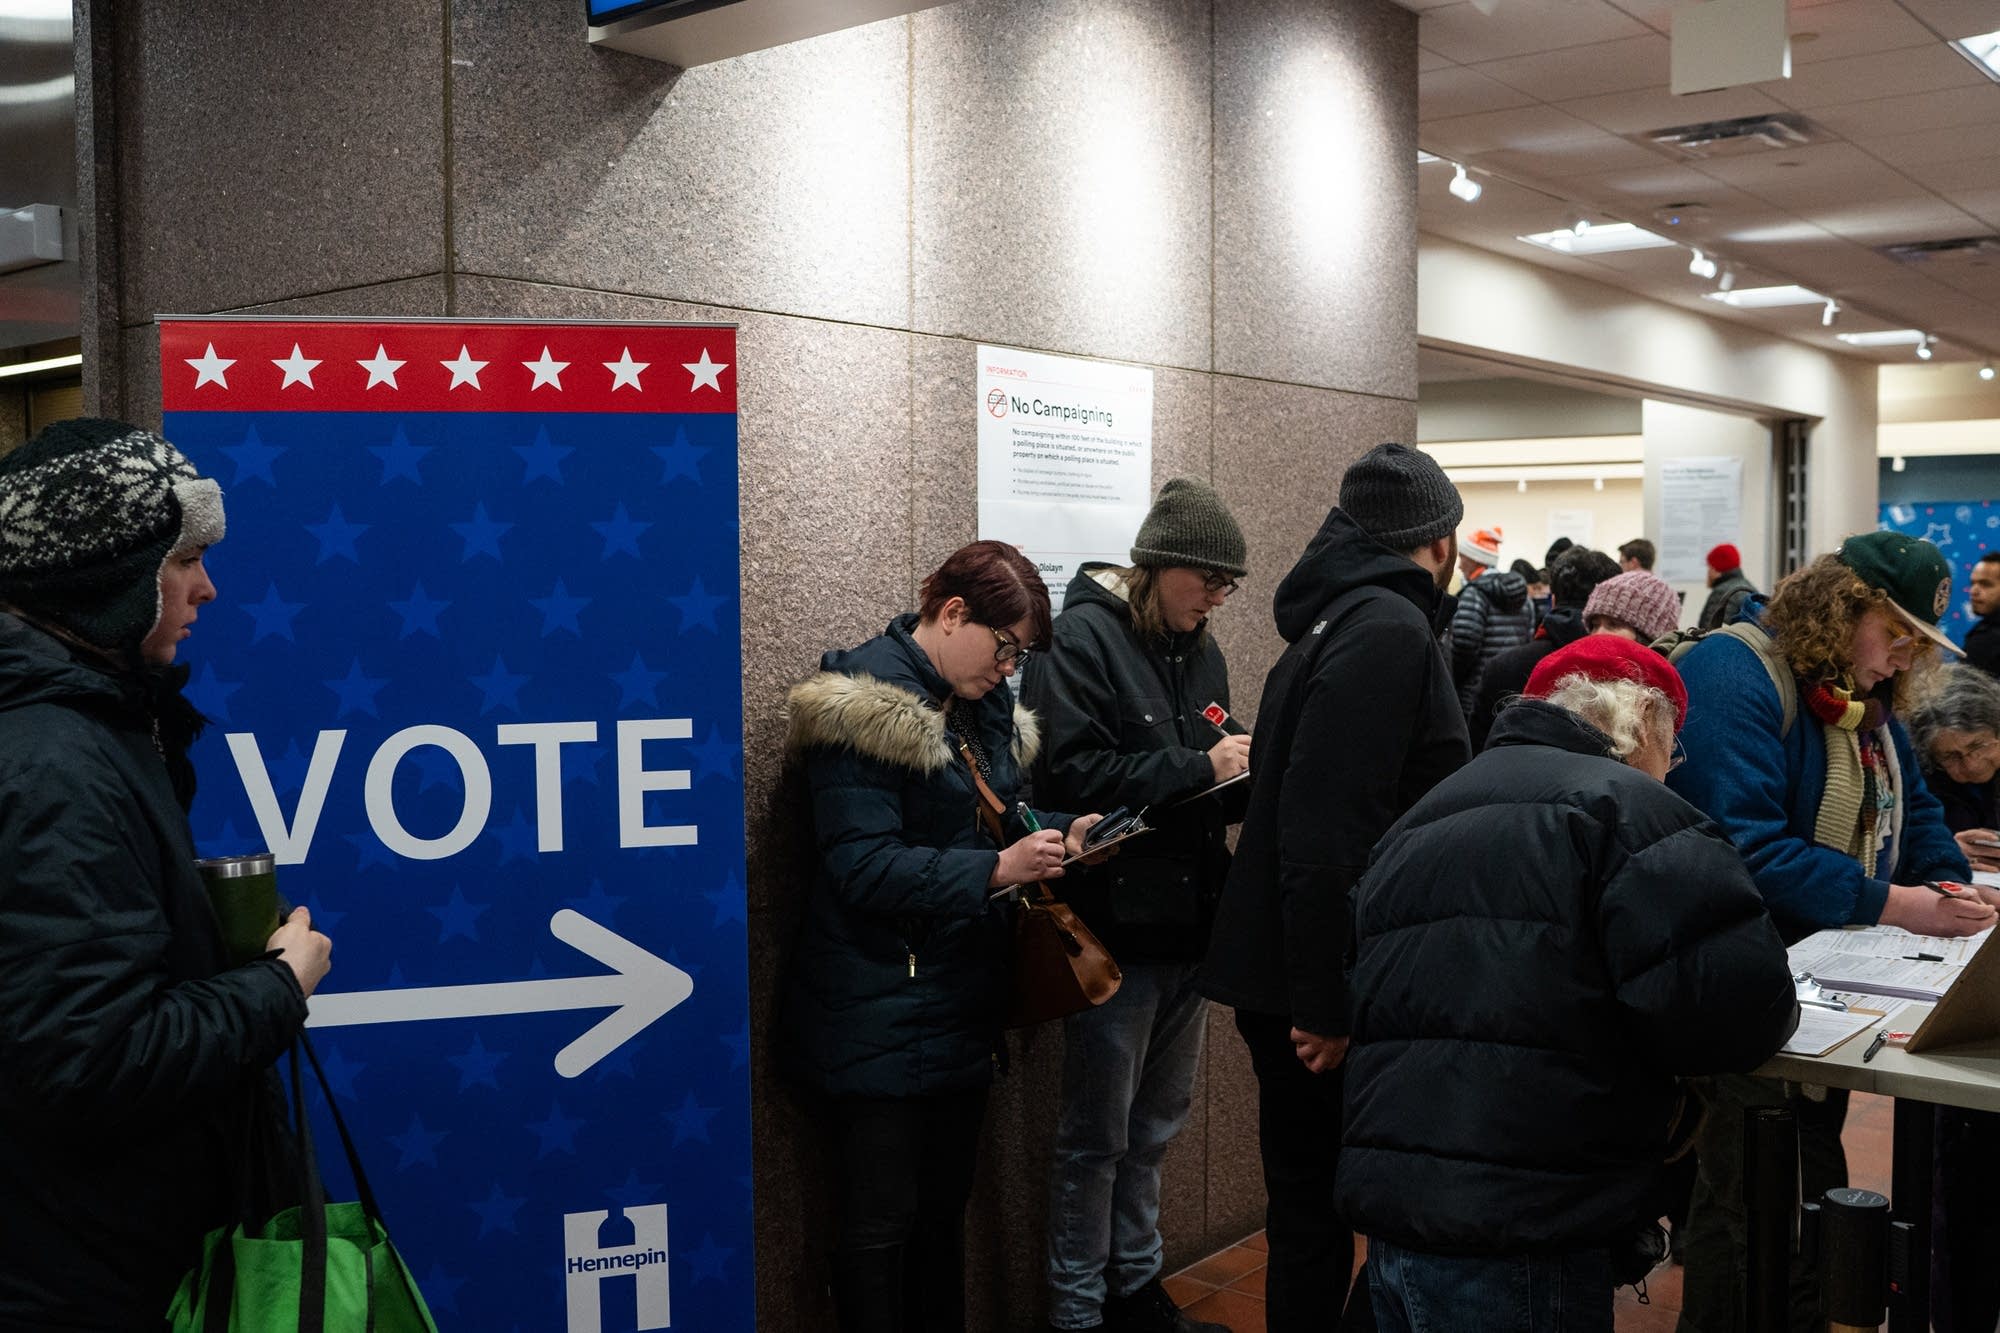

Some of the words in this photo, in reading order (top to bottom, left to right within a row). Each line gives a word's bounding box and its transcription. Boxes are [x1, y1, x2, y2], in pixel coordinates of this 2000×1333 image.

[985, 365, 1028, 378] INFORMATION
[1012, 396, 1030, 415] No
[1033, 398, 1113, 428] Campaigning
[1012, 427, 1020, 436] No
[1021, 430, 1054, 440] campaigning
[1017, 440, 1035, 449] polling
[1036, 441, 1050, 450] place
[1012, 451, 1036, 460] property
[1044, 453, 1060, 461] which
[1064, 455, 1081, 464] polling
[224, 718, 698, 866] VOTE
[567, 1248, 666, 1274] Hennepin
